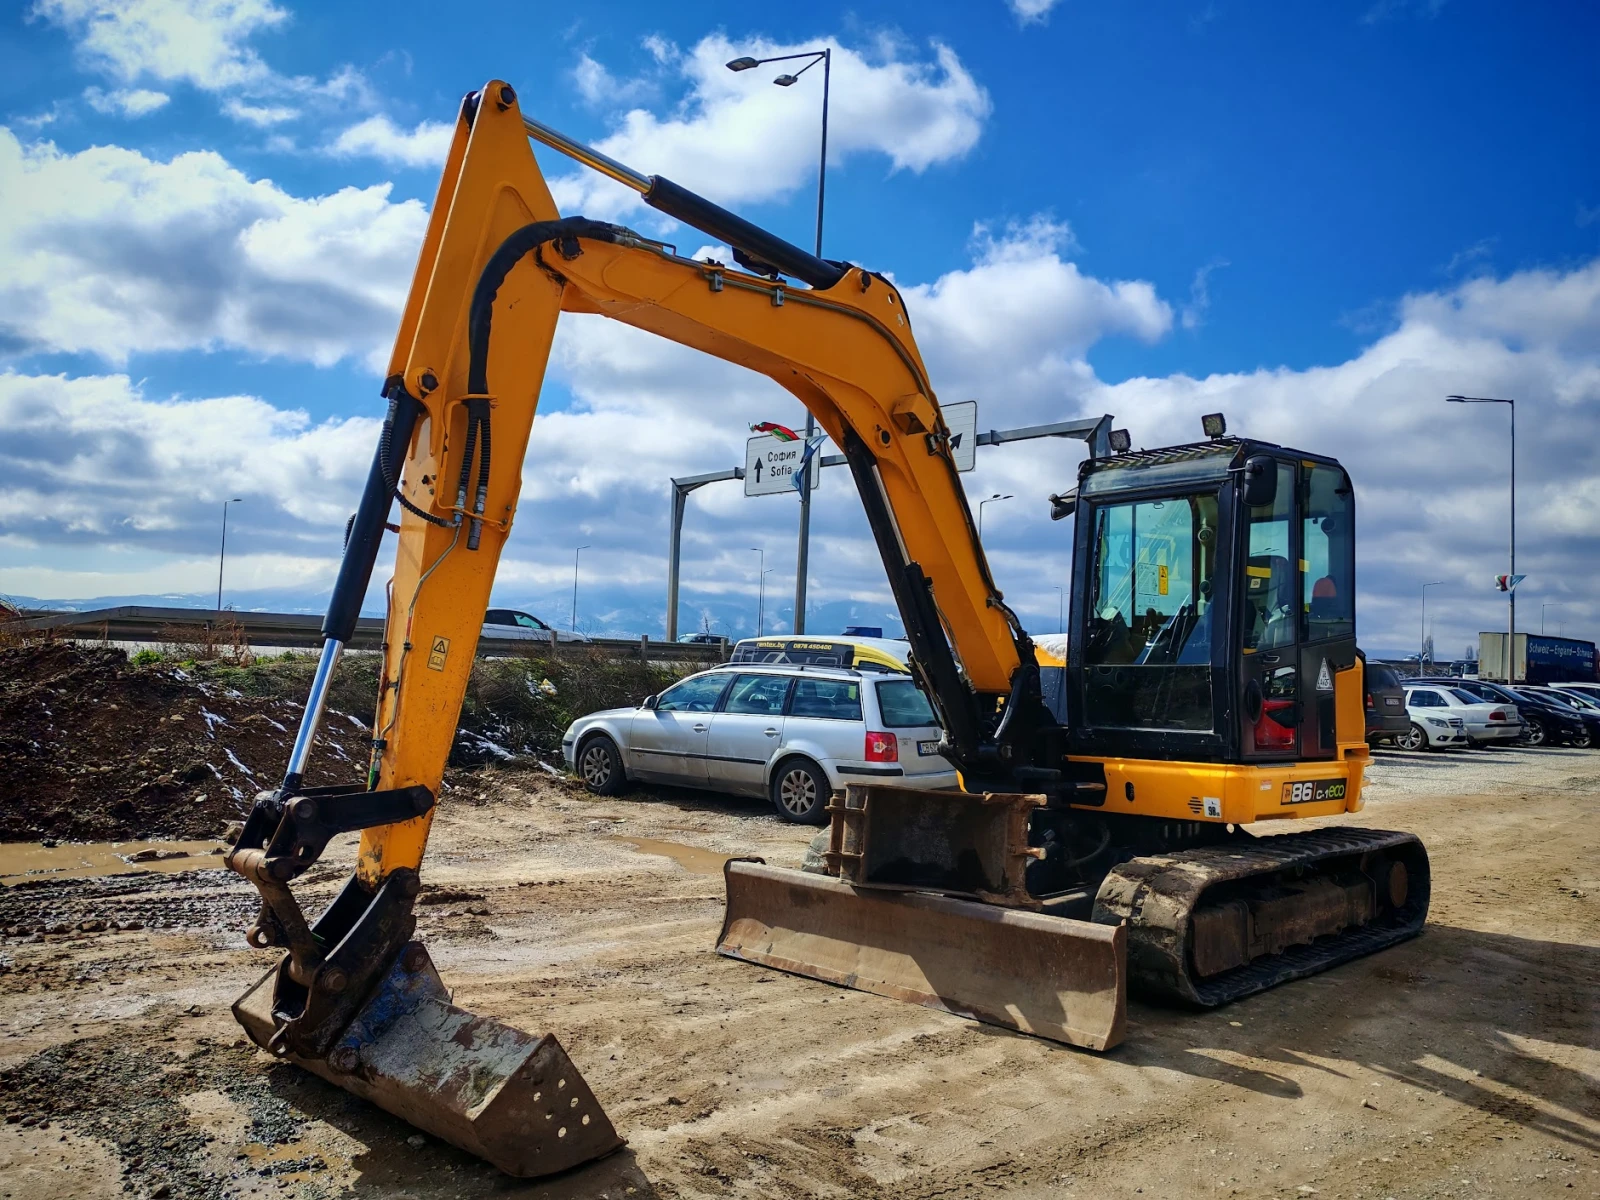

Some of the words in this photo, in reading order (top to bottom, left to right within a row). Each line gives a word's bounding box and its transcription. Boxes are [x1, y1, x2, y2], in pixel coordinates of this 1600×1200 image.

[767, 451, 796, 462] София
[770, 465, 792, 477] Sofia
[1291, 782, 1313, 803] 86
